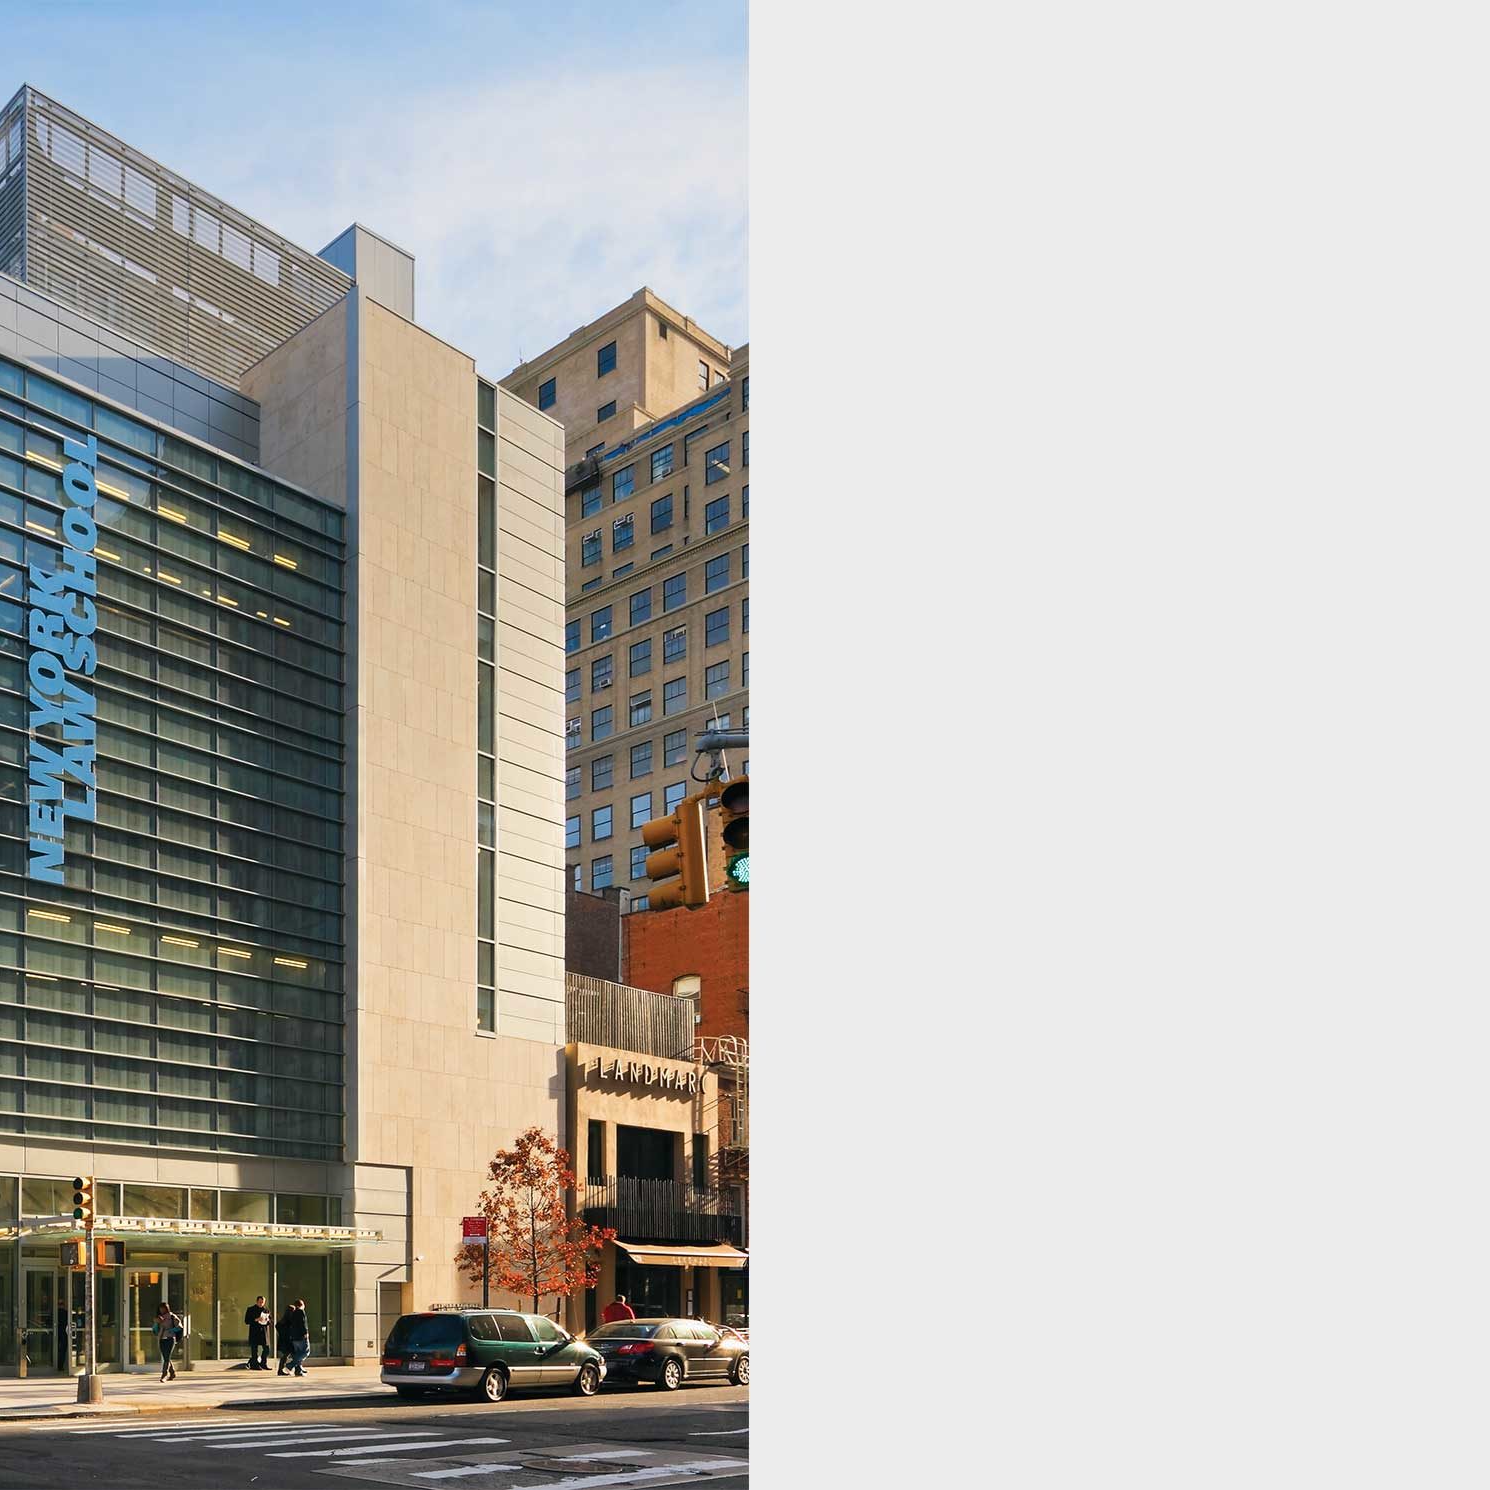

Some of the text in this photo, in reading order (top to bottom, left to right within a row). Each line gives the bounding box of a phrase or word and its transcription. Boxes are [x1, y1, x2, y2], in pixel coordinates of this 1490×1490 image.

[28, 561, 65, 886] NEW YORK
[62, 433, 98, 822] LAW SCHOOL
